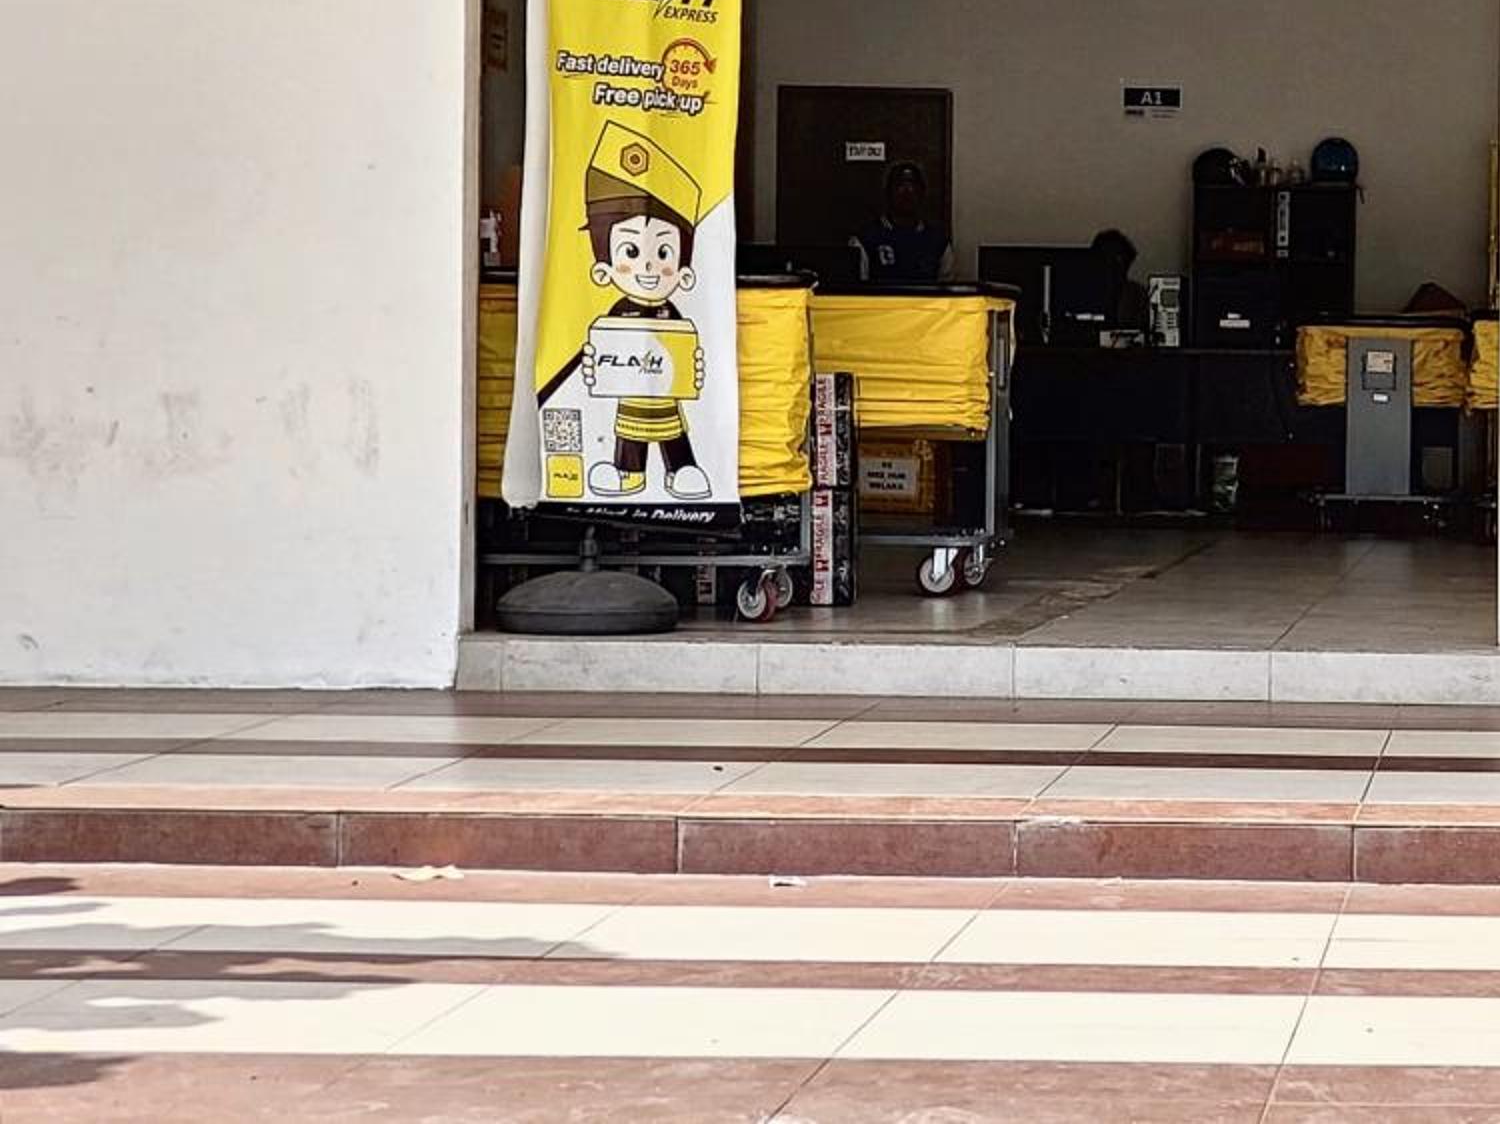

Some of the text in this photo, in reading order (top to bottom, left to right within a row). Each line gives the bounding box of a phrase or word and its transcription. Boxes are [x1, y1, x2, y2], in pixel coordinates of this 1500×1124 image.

[663, 6, 719, 24] EXPRESS
[557, 50, 666, 82] Fast delivery
[669, 59, 701, 75] 365
[670, 76, 699, 90] Days
[594, 82, 704, 116] Free pick up
[1139, 91, 1163, 105] A1
[597, 351, 663, 370] FLASH
[816, 377, 829, 424] FRAGILE
[815, 514, 826, 558] FRAGILE
